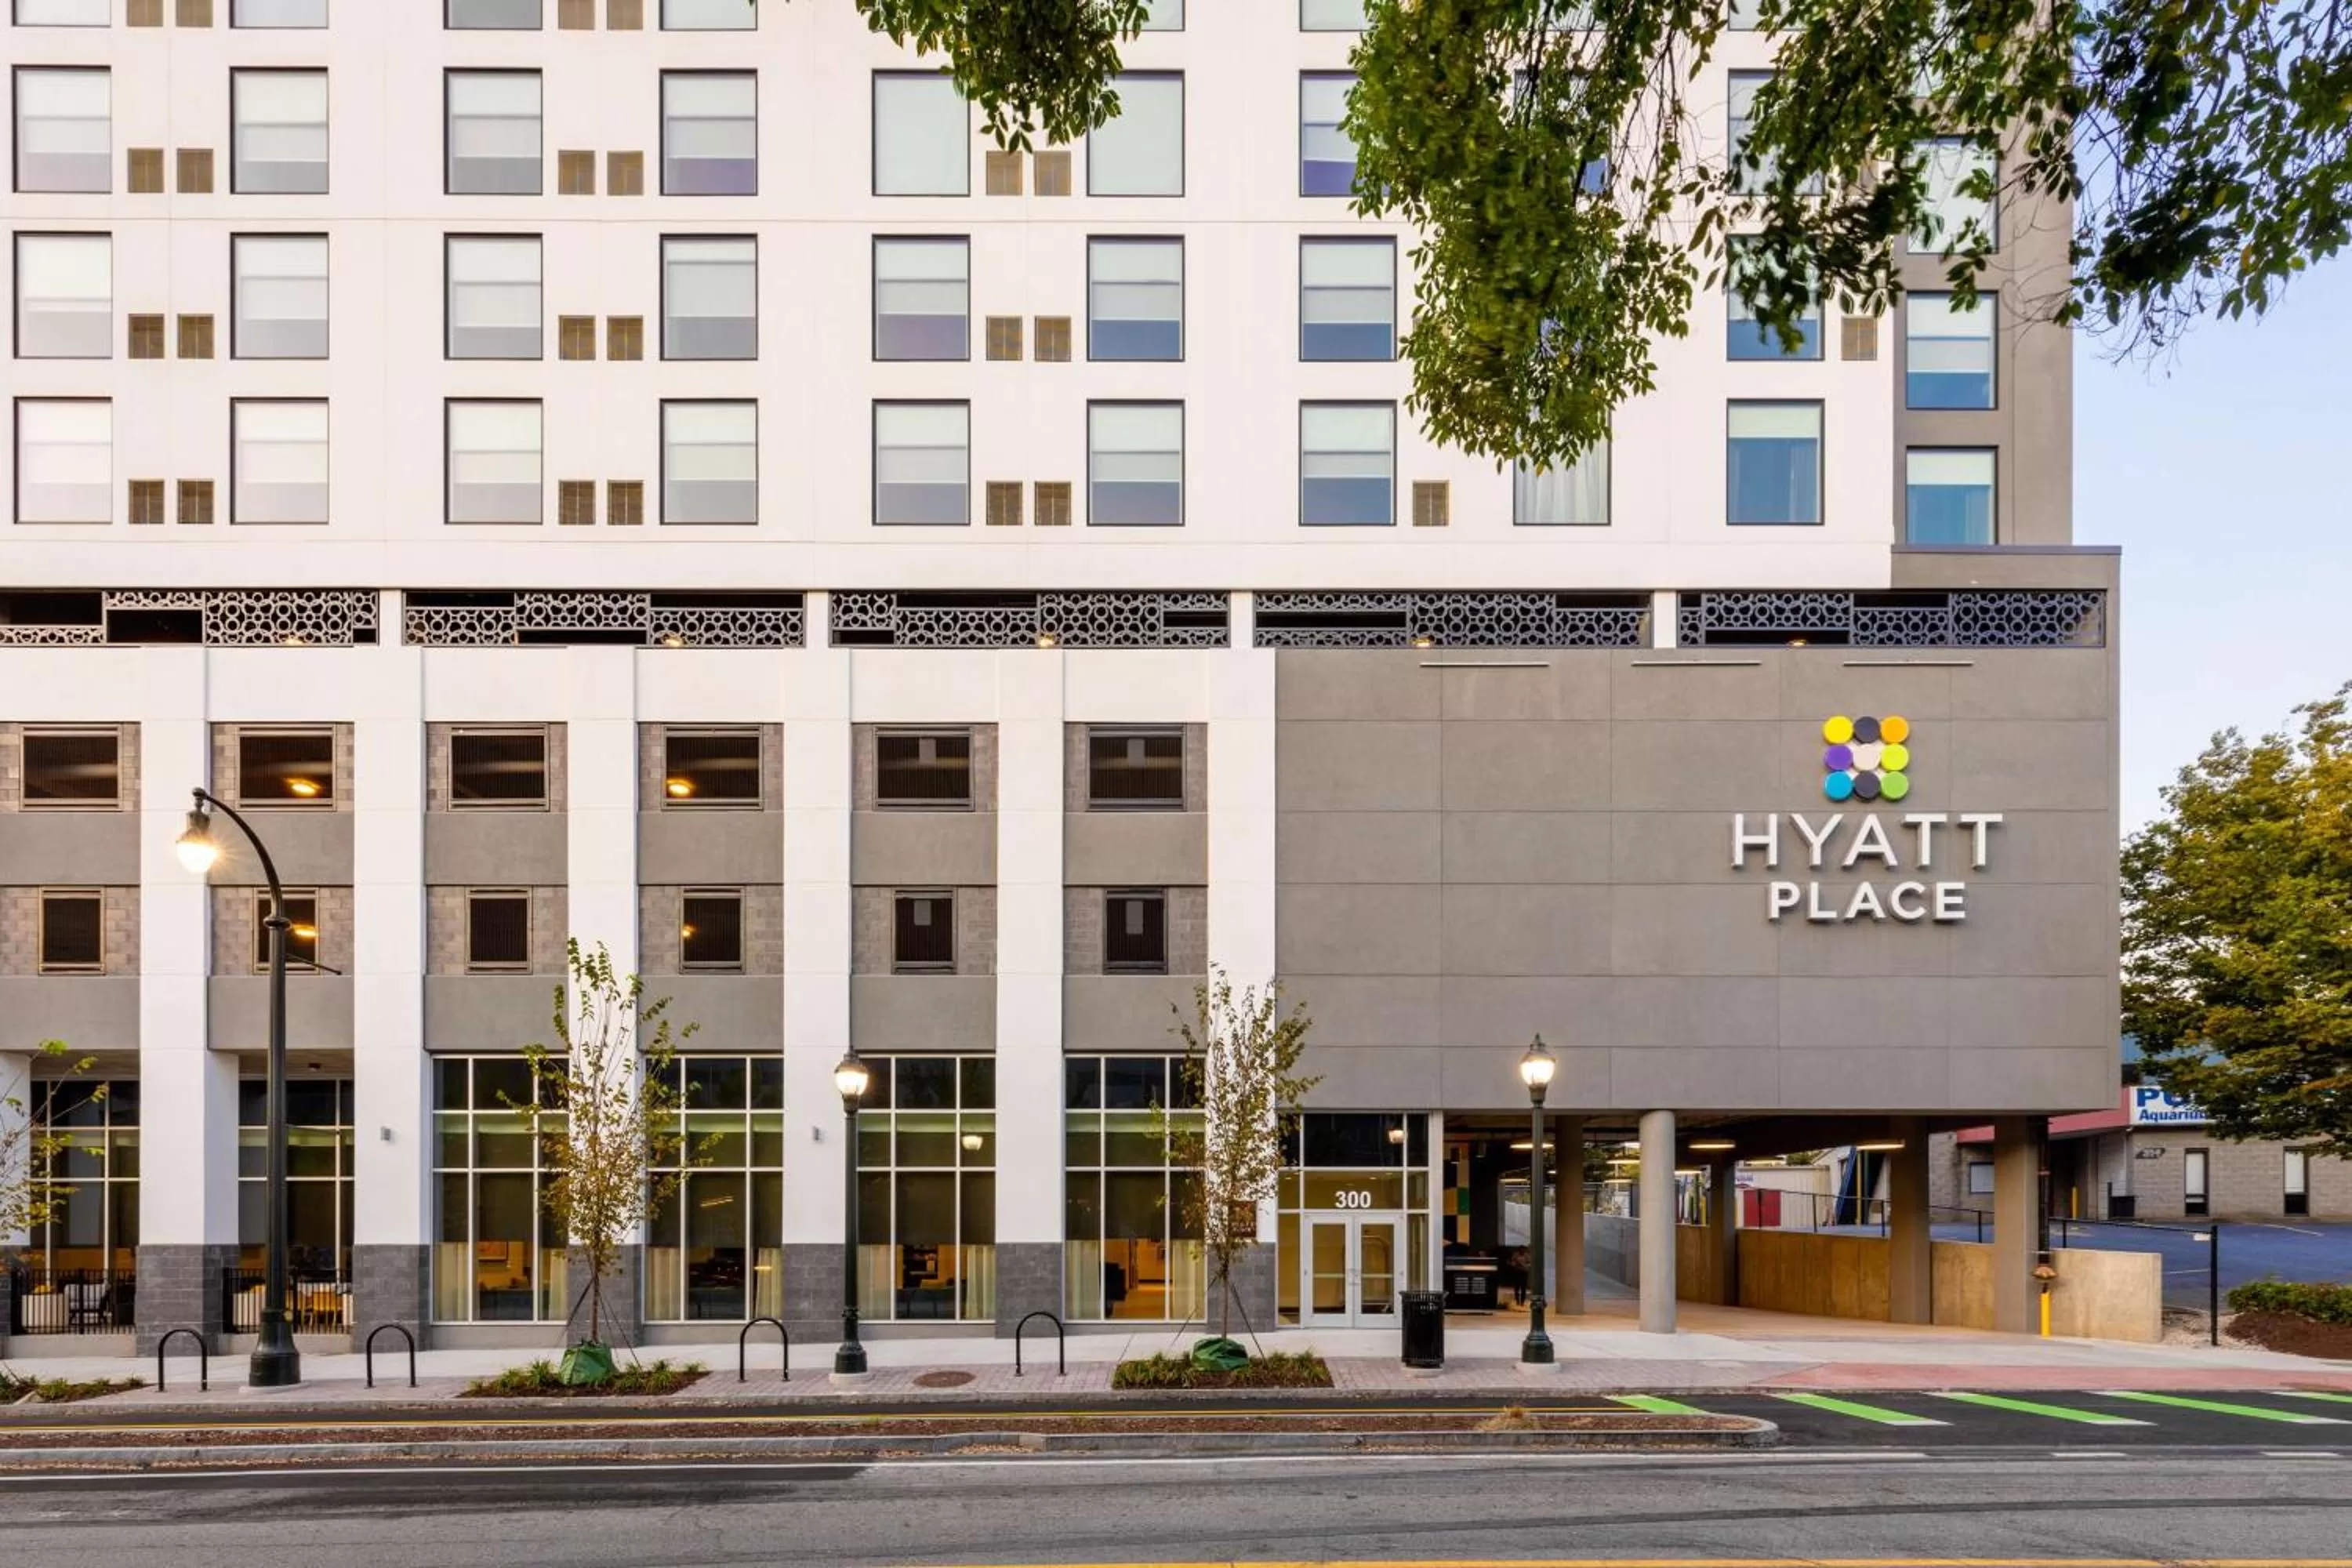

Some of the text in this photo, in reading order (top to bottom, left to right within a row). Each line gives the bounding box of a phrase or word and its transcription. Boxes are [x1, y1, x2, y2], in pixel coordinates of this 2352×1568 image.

[1731, 813, 2004, 869] HYATT
[1768, 881, 1967, 921] PLACE
[1335, 1191, 1372, 1208] 300
